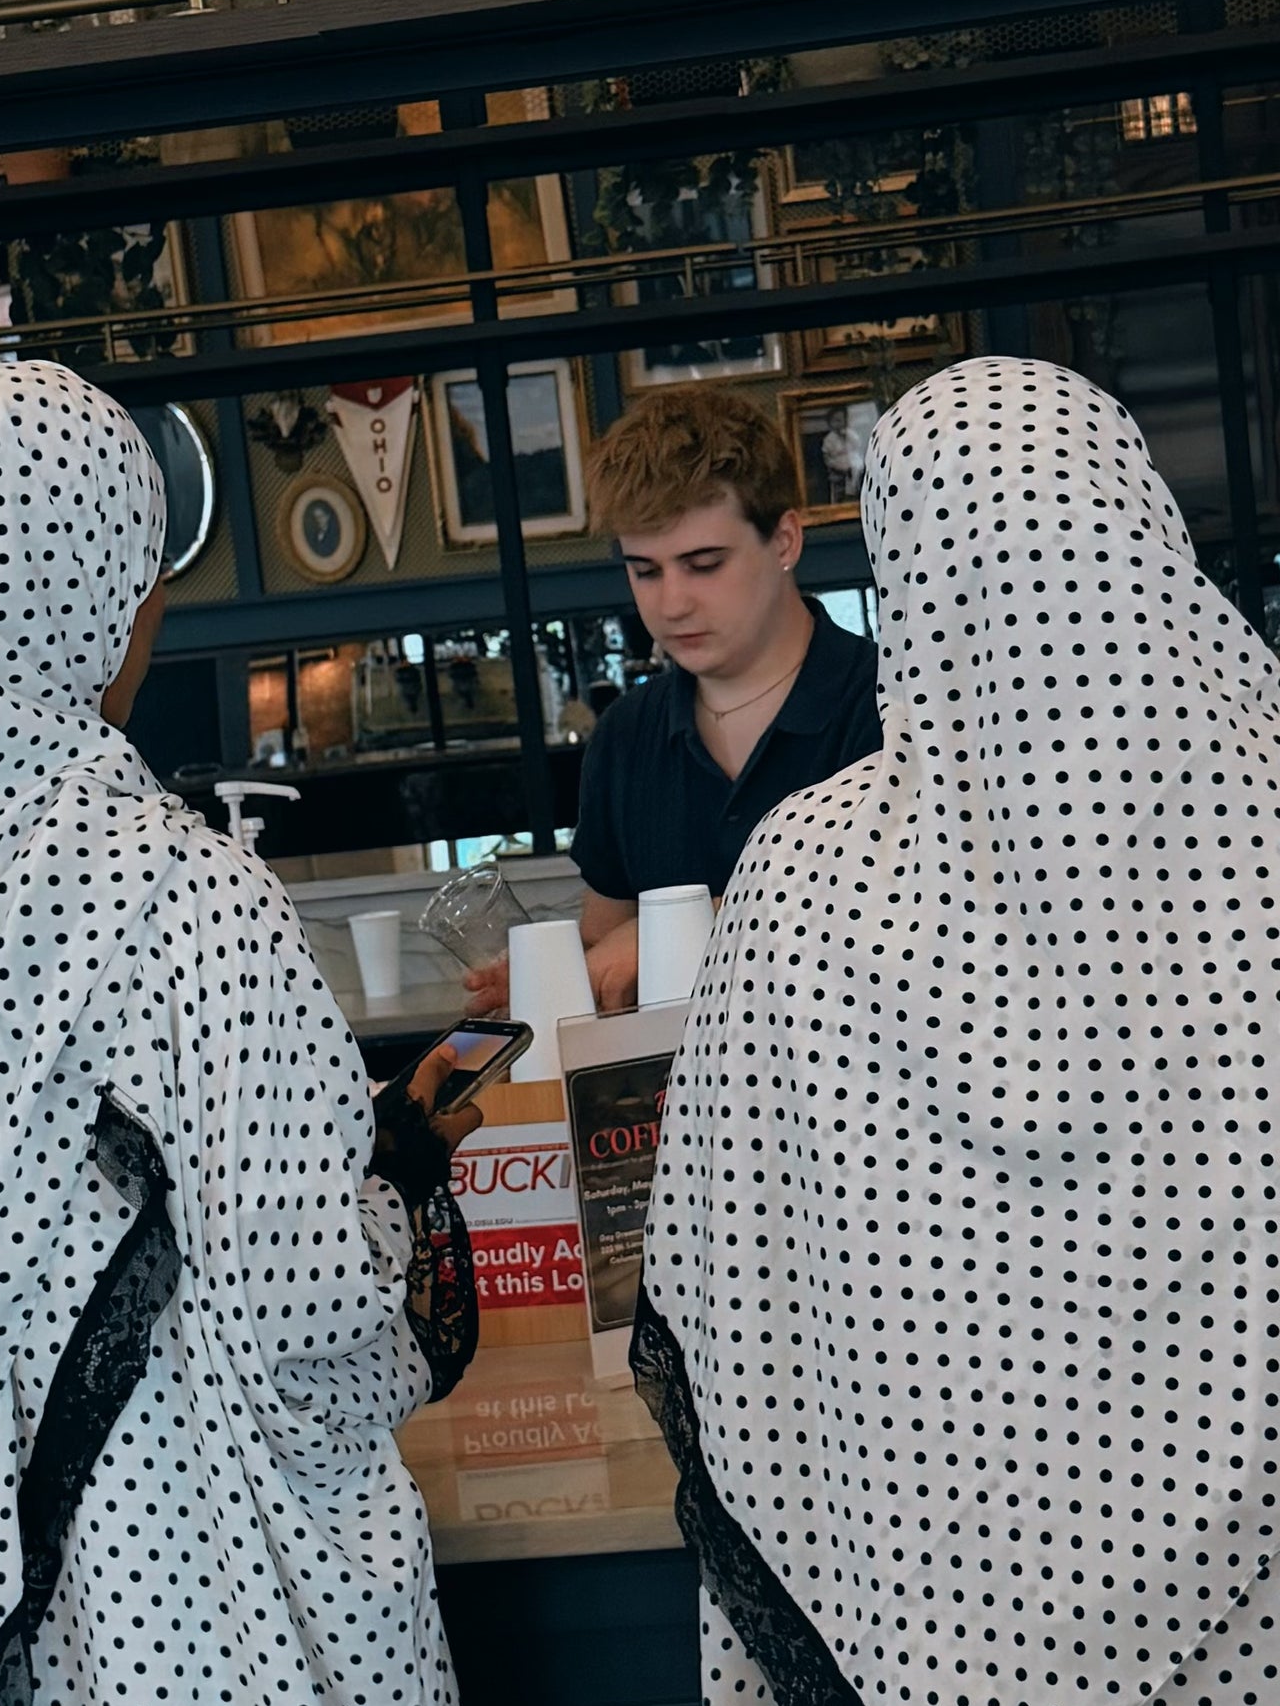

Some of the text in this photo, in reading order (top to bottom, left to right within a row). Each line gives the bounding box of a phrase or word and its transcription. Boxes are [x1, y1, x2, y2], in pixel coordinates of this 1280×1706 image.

[370, 418, 392, 492] OHIO
[472, 1242, 545, 1268] oudly
[495, 1271, 544, 1295] this
